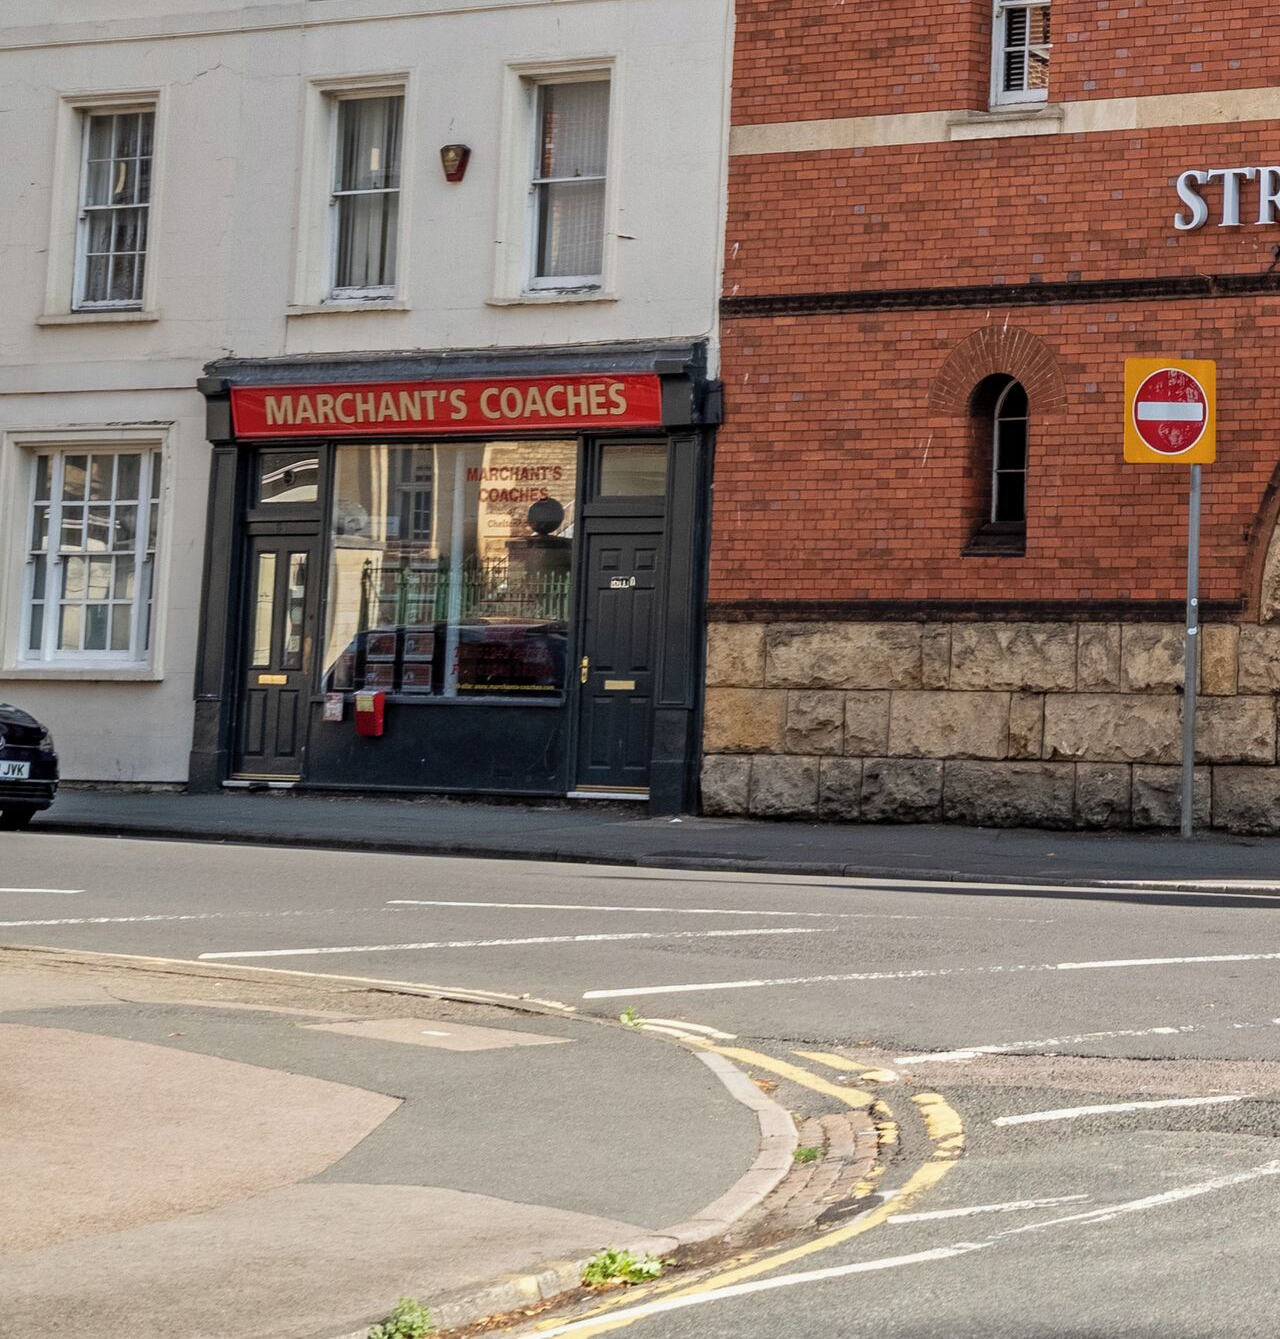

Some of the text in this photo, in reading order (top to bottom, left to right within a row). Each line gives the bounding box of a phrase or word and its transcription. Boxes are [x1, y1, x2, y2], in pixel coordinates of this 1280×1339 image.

[264, 382, 627, 426] MARCHANT'S COACHES
[467, 465, 562, 482] MARCHANT'S
[479, 487, 549, 502] COACHES
